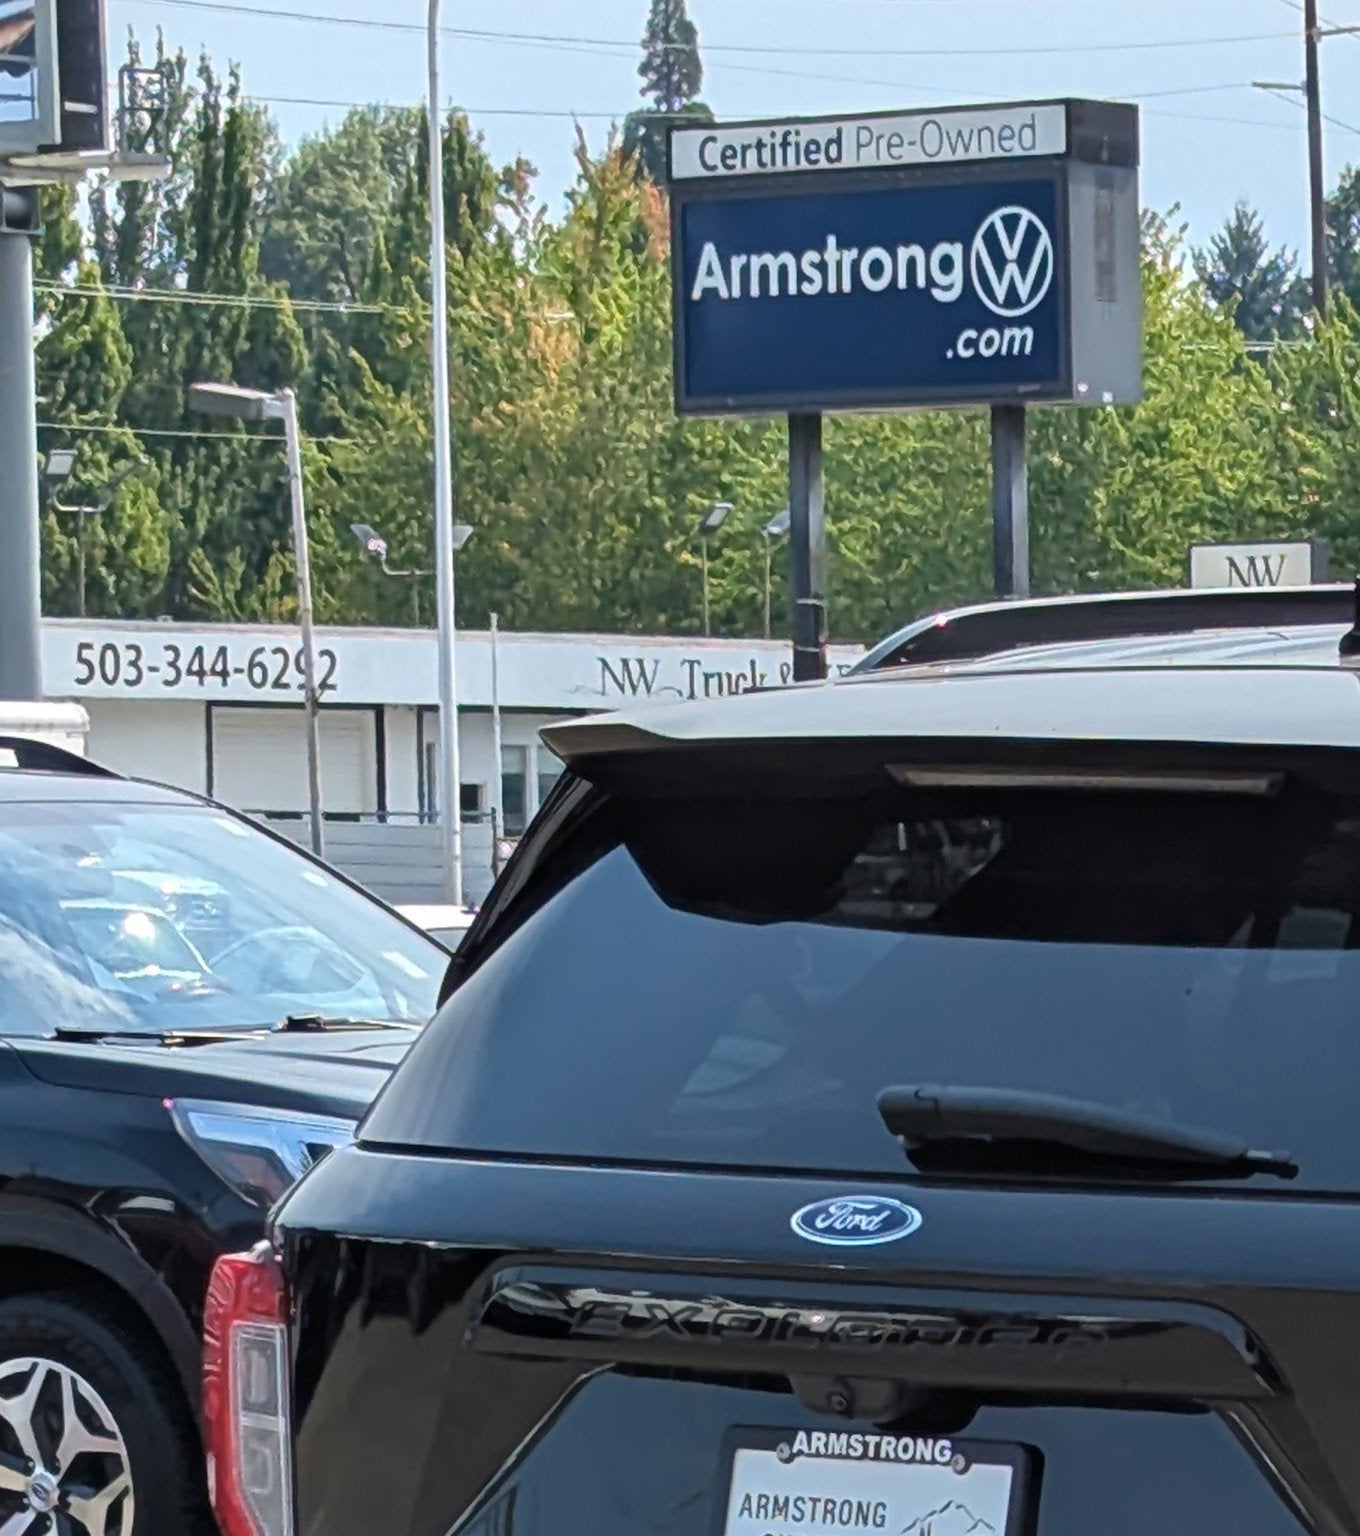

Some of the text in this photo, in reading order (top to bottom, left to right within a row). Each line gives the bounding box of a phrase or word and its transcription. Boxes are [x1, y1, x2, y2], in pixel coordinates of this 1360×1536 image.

[699, 113, 1037, 173] Certified Pre-Owned
[690, 234, 964, 302] Armstrong
[944, 325, 1035, 360] .com
[1224, 553, 1287, 587] NW
[597, 656, 660, 697] NW
[814, 1201, 892, 1231] Ford
[791, 1430, 953, 1463] ARMSTRONG
[737, 1492, 888, 1529] ARMSTRONG
